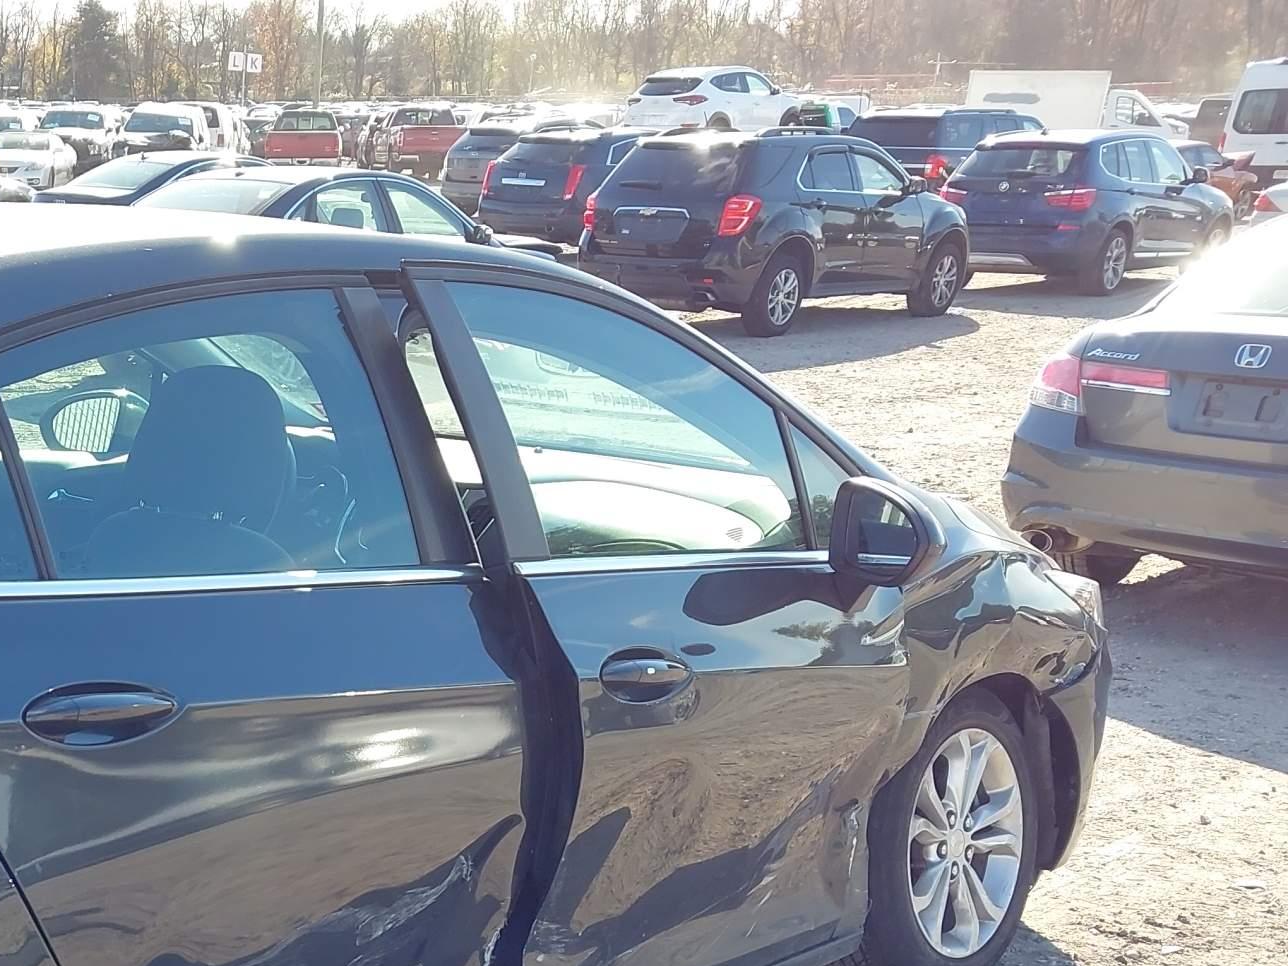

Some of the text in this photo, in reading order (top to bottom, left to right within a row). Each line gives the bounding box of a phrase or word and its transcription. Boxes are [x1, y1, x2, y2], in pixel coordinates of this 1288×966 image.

[232, 55, 240, 68] L
[250, 57, 259, 70] K
[1087, 348, 1140, 361] Accord
